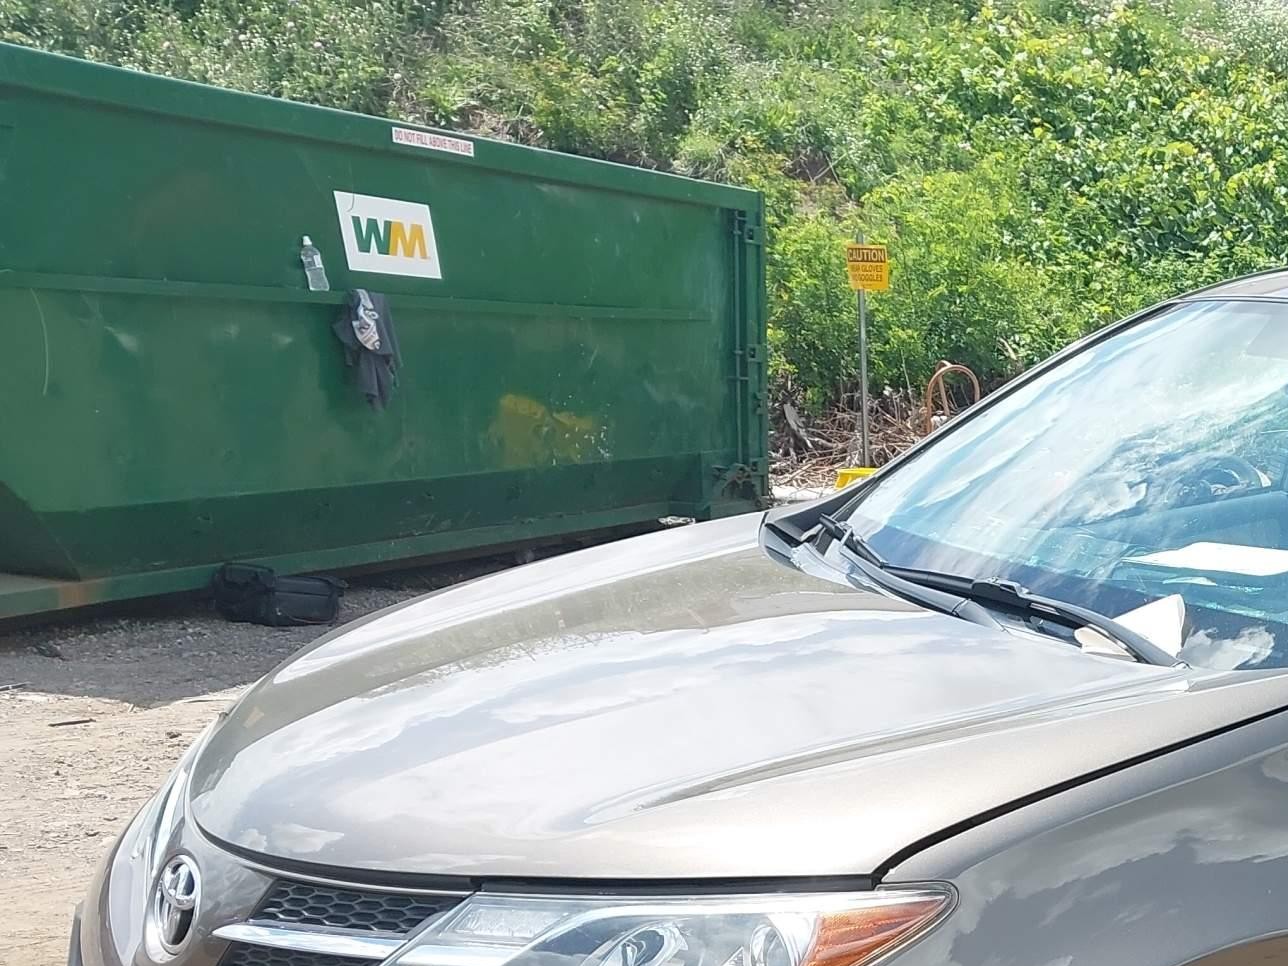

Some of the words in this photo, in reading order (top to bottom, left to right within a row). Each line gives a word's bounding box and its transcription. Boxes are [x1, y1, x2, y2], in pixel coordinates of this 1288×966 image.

[404, 130, 415, 143] NOT
[416, 133, 428, 145] FILL
[429, 135, 448, 149] ABOVE
[350, 215, 428, 259] WM
[847, 248, 885, 262] CAUTION
